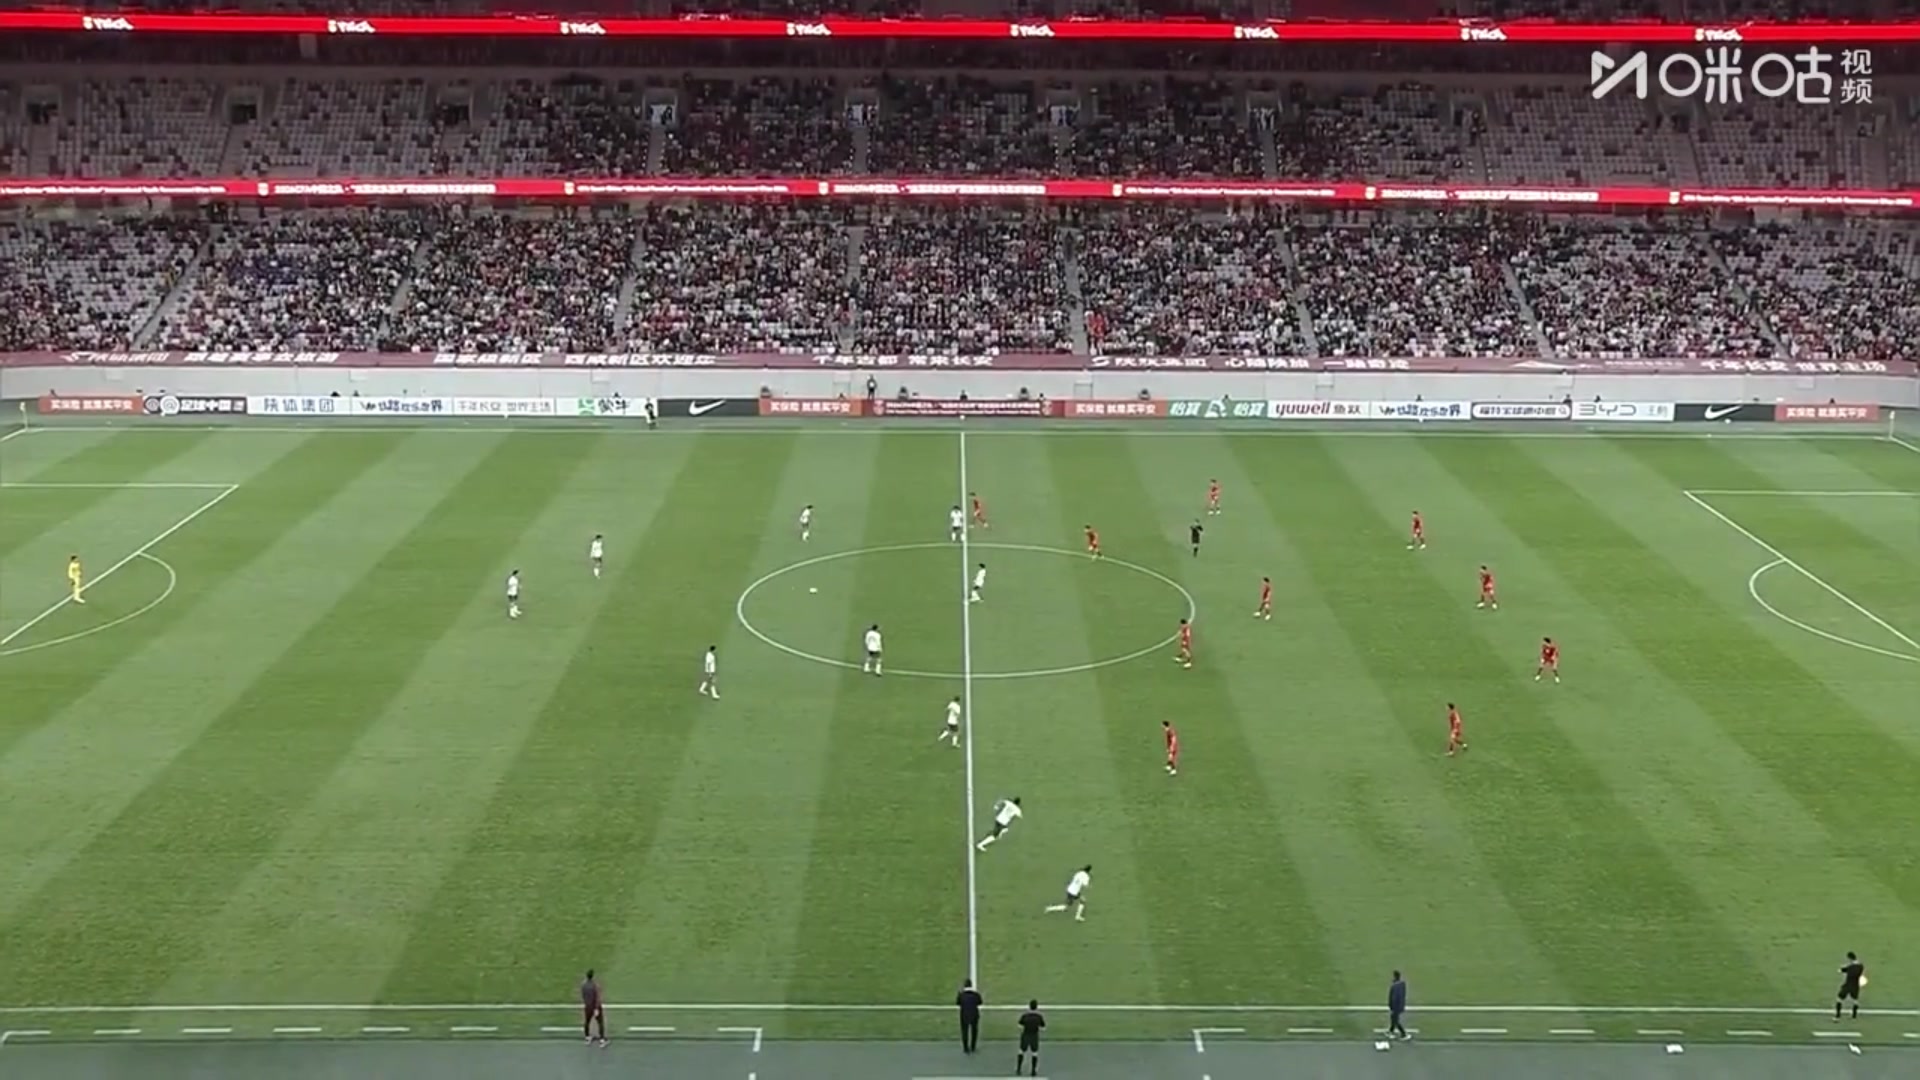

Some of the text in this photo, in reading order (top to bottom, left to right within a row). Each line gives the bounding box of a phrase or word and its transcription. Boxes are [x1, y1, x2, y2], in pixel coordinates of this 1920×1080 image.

[812, 355, 993, 365] 千年古都 常来长安
[51, 399, 133, 410] 买保险 就是买平安
[598, 398, 630, 414] 蒙牛
[770, 401, 851, 413] 买保险 就是买平安
[1076, 403, 1156, 414] 买保险 就是买平安
[1275, 402, 1331, 417] yuwell
[1333, 403, 1361, 414] 鱼跃
[1579, 404, 1637, 416] BYD
[1786, 407, 1868, 418] 买保险 就是买平安
